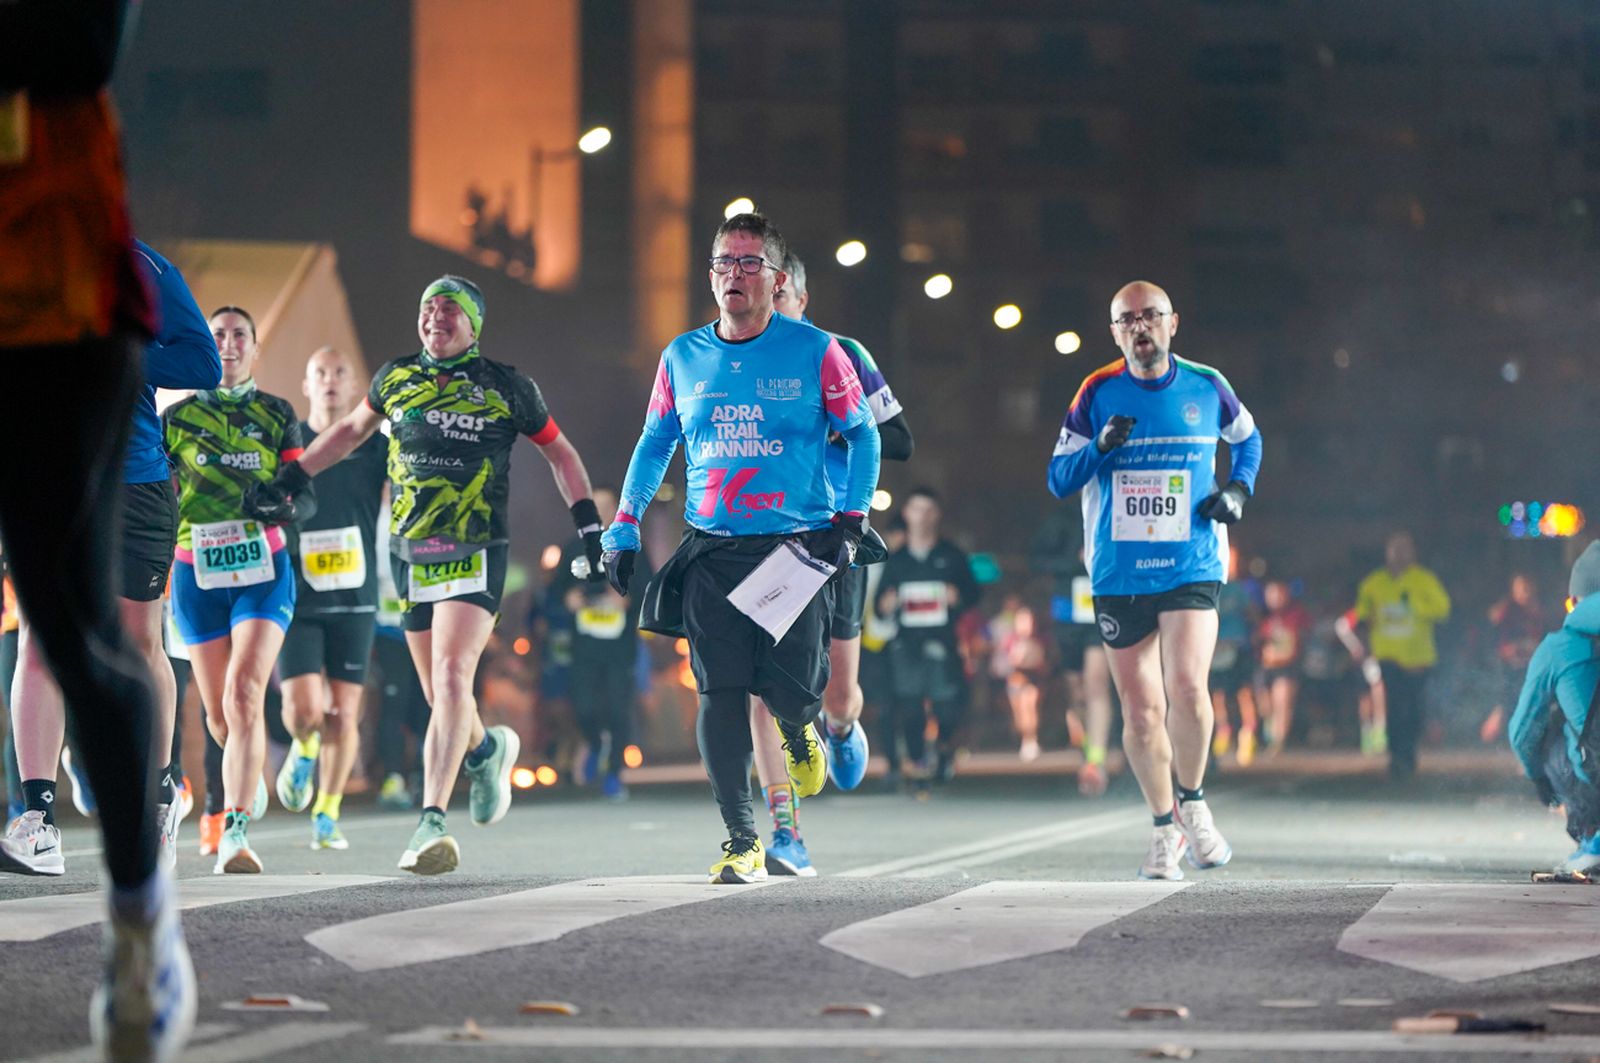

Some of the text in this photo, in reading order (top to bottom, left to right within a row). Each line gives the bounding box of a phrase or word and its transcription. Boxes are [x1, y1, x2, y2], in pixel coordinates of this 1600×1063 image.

[710, 404, 765, 422] ADRA
[443, 429, 480, 443] TRAIL
[714, 422, 763, 439] TRAIL
[701, 439, 784, 458] RUNNING
[1126, 496, 1176, 516] 6069
[202, 540, 262, 567] 12039
[317, 551, 352, 569] 6757
[424, 556, 473, 579] 12178
